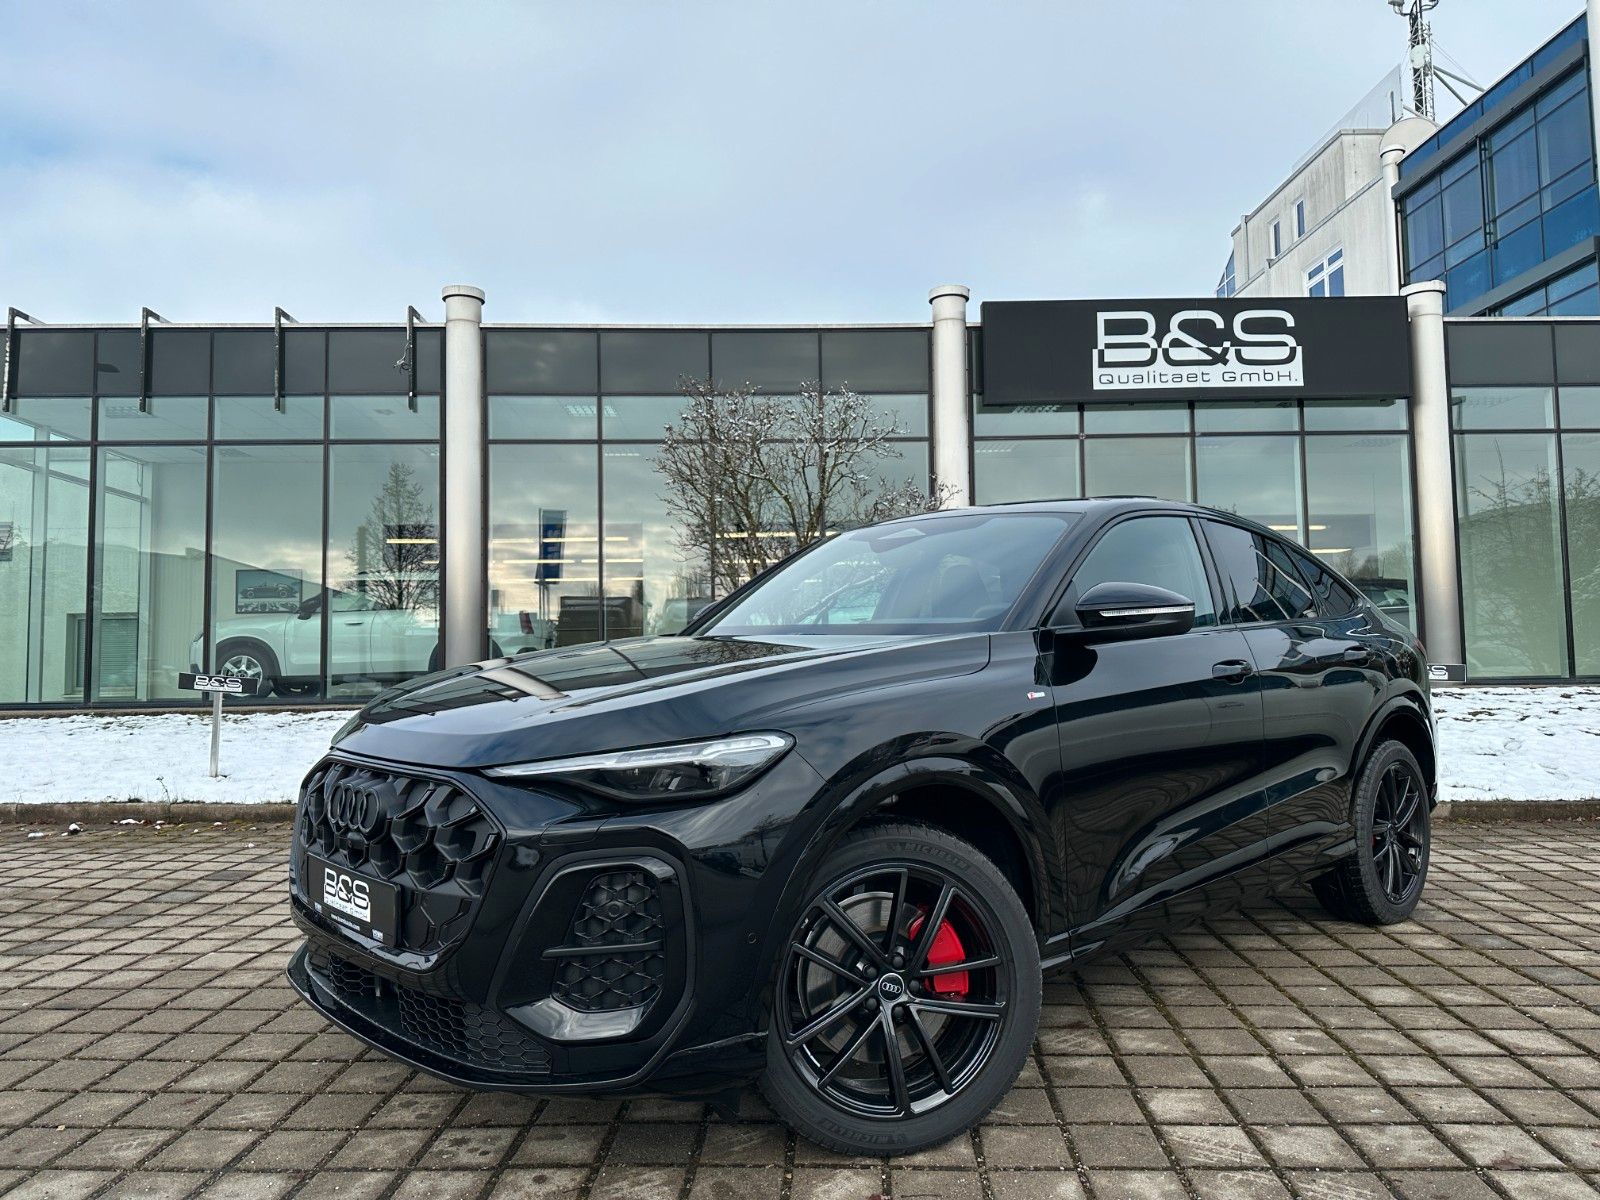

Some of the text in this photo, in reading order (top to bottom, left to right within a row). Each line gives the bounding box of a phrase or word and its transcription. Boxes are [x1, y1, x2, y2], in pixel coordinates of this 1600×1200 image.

[1096, 309, 1298, 369] B&S
[1099, 368, 1299, 385] Qualitaet GmbH.
[195, 675, 242, 689] B&S
[324, 867, 370, 911] B&S
